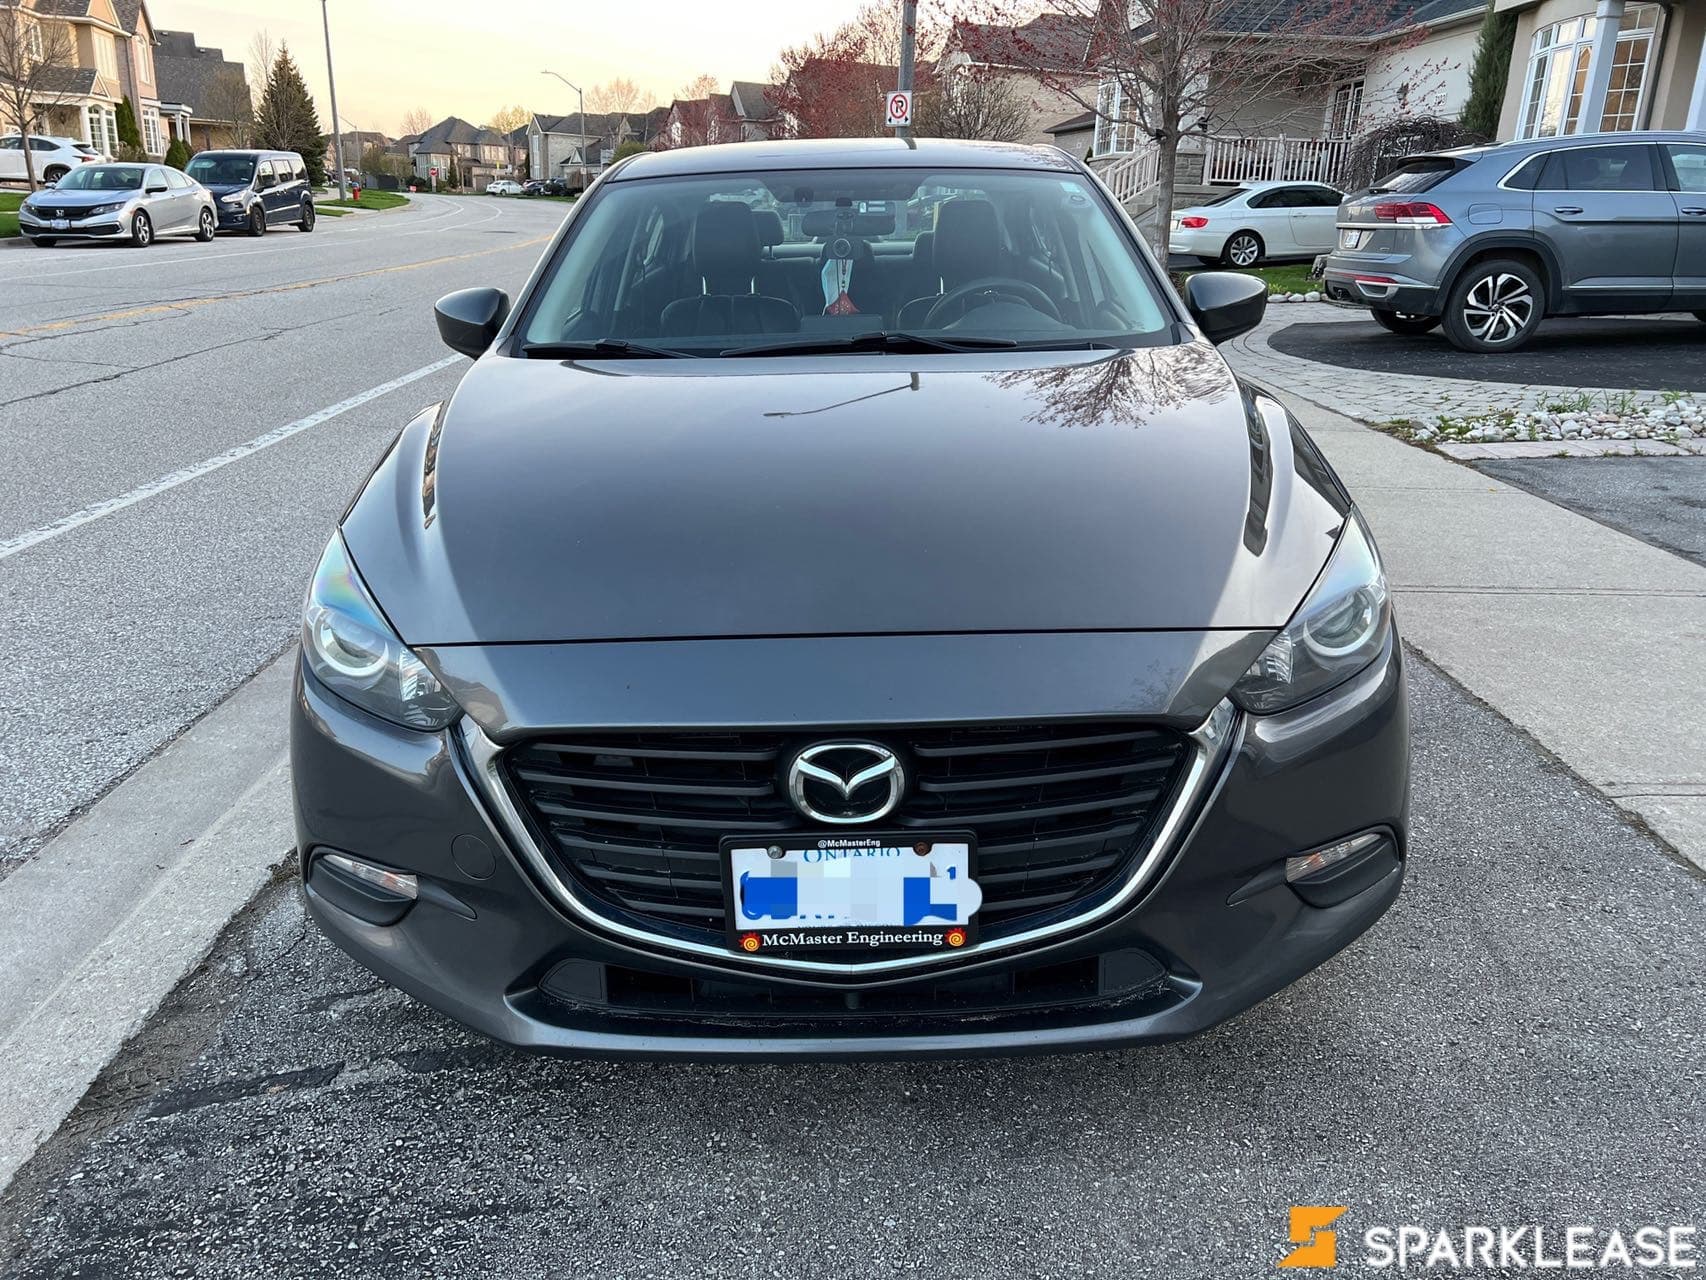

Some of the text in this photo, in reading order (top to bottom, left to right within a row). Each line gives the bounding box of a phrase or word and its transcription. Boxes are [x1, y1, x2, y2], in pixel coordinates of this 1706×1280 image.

[817, 839, 881, 848] @McMasterEng
[762, 931, 943, 947] McMaster Engineering
